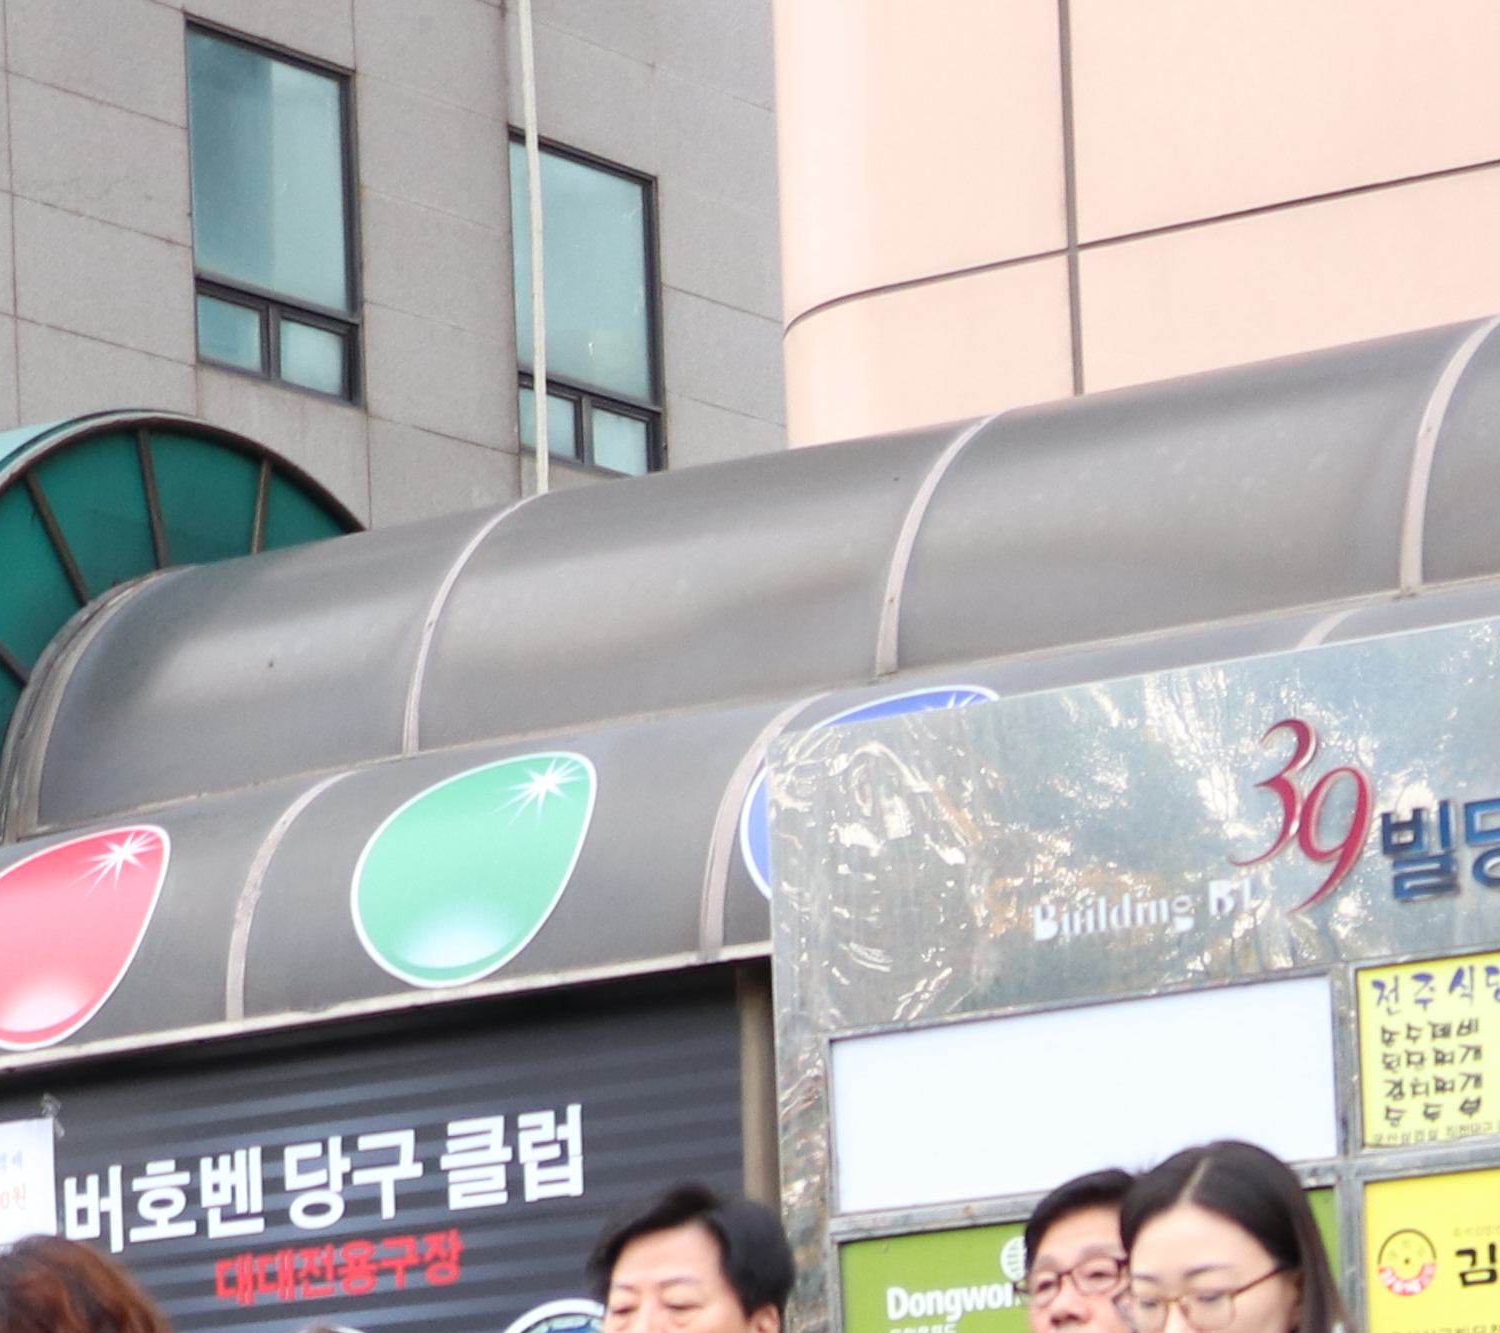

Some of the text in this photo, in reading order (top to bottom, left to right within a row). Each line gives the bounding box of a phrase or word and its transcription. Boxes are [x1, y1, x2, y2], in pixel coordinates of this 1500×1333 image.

[1228, 718, 1375, 914] 39
[1033, 893, 1194, 942] Building
[63, 1102, 585, 1253] 버호벤 당구 클럽
[215, 1228, 465, 1306] 대대전용구장
